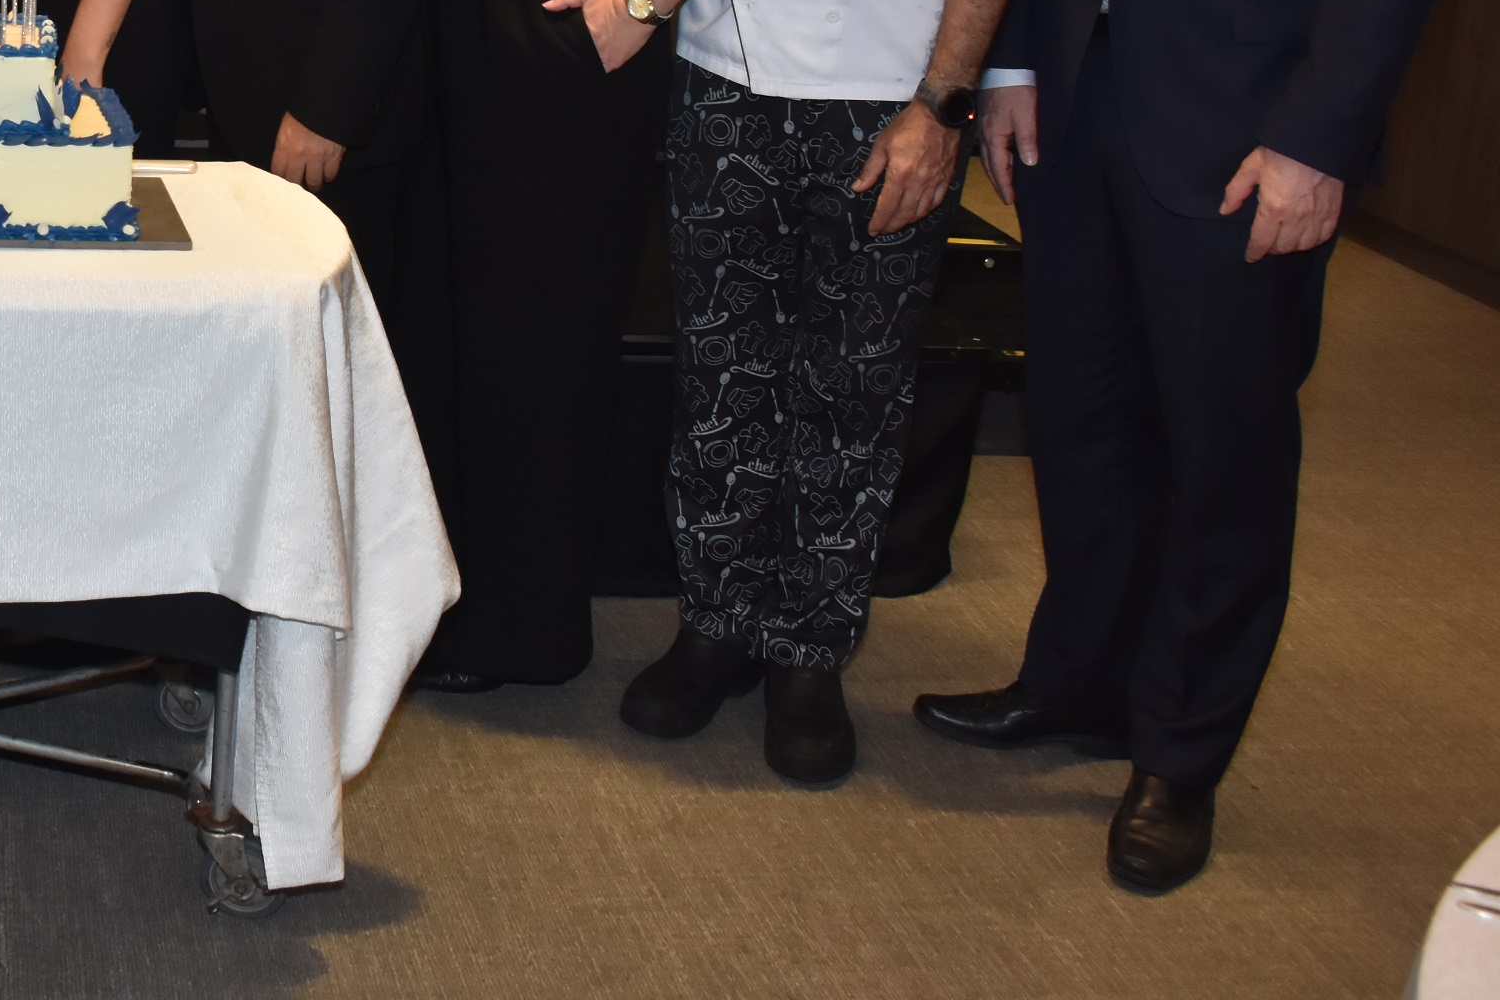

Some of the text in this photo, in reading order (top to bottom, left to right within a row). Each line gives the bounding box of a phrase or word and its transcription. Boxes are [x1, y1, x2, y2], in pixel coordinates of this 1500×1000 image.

[703, 82, 729, 103] chef
[744, 153, 775, 177] chef
[821, 170, 852, 189] chef
[740, 258, 773, 275] chef
[818, 275, 842, 295] hef
[690, 308, 716, 328] chef
[859, 336, 889, 357] chef
[744, 357, 772, 373] chef
[692, 413, 720, 434] chef
[850, 440, 875, 456] chef
[747, 457, 777, 474] chef
[701, 510, 728, 525] chef
[815, 530, 843, 547] chef
